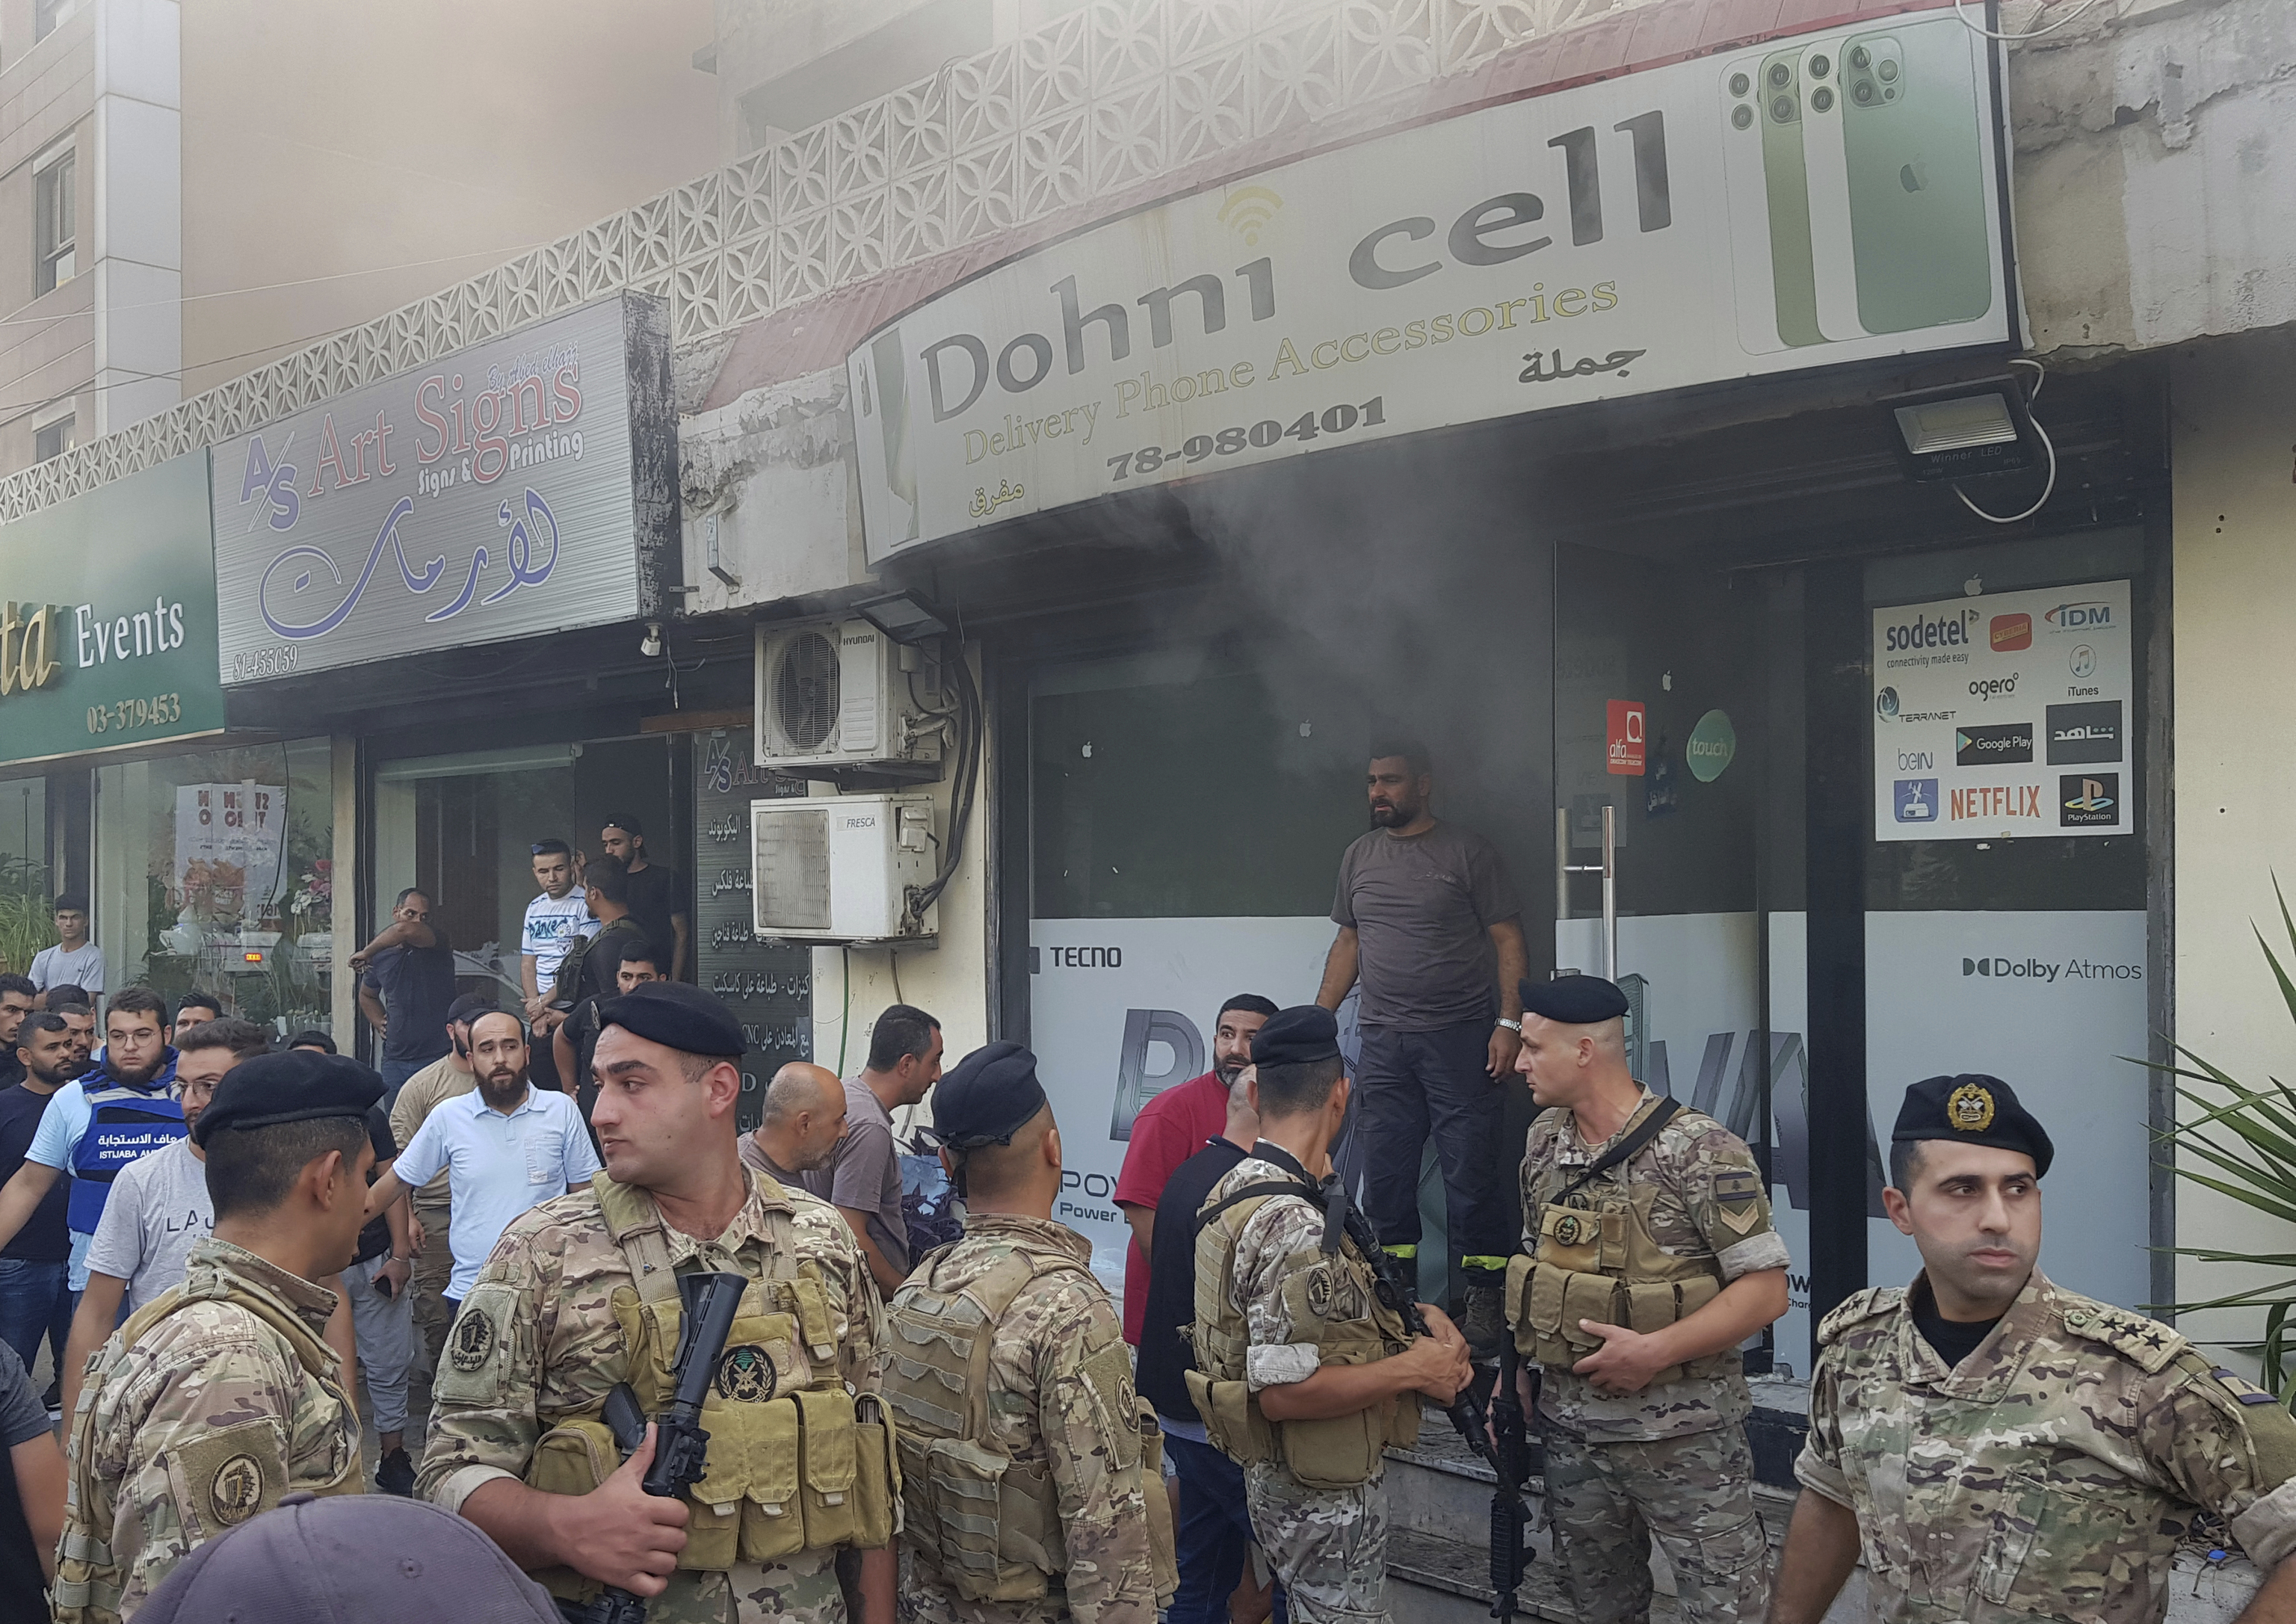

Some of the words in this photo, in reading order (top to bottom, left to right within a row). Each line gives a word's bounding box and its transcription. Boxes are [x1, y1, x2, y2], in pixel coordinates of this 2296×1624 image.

[920, 257, 1276, 424] Dohni
[1348, 110, 1672, 291] cell
[964, 401, 1101, 465] Delivery
[1114, 362, 1256, 420] Phone
[1268, 280, 1620, 381] Accessories
[1518, 346, 1647, 384] جملة
[307, 412, 396, 498] Art
[415, 362, 581, 484] Signs
[1106, 397, 1386, 483] 78-980401
[418, 467, 457, 498] Signs
[509, 430, 585, 472] Printing
[1931, 451, 1972, 463] Winner
[1981, 446, 2002, 457] LED
[969, 478, 1025, 519] مفرق
[843, 635, 875, 646] HYUNDAI
[1886, 610, 1969, 652] sodetel
[0, 601, 61, 697] ta
[75, 596, 185, 669] Events
[232, 644, 299, 680] 81-455059
[1886, 655, 1930, 668] connectivity
[1931, 653, 1951, 664] made
[1952, 652, 1969, 664] easy
[2068, 685, 2099, 697] iTunes
[87, 692, 182, 734] 03-379453
[1899, 711, 1957, 723] TERRANET
[1976, 738, 2011, 752] Google
[2012, 736, 2032, 750] Play
[2054, 726, 2114, 741] شاهد
[1609, 738, 1627, 759] alfa
[1692, 738, 1728, 756] touch
[1951, 785, 2041, 821] NETFLIX
[846, 816, 876, 829] FRESCA
[2067, 812, 2111, 821] PlayStation
[1050, 946, 1122, 968] TECNO
[1995, 958, 2061, 983] Dolby
[2065, 958, 2142, 980] Atmos
[756, 973, 777, 1001] طباعة
[98, 1134, 151, 1147] الاستجابة
[99, 1149, 137, 1159] ISTIJABA
[1060, 1202, 1117, 1223] Power
